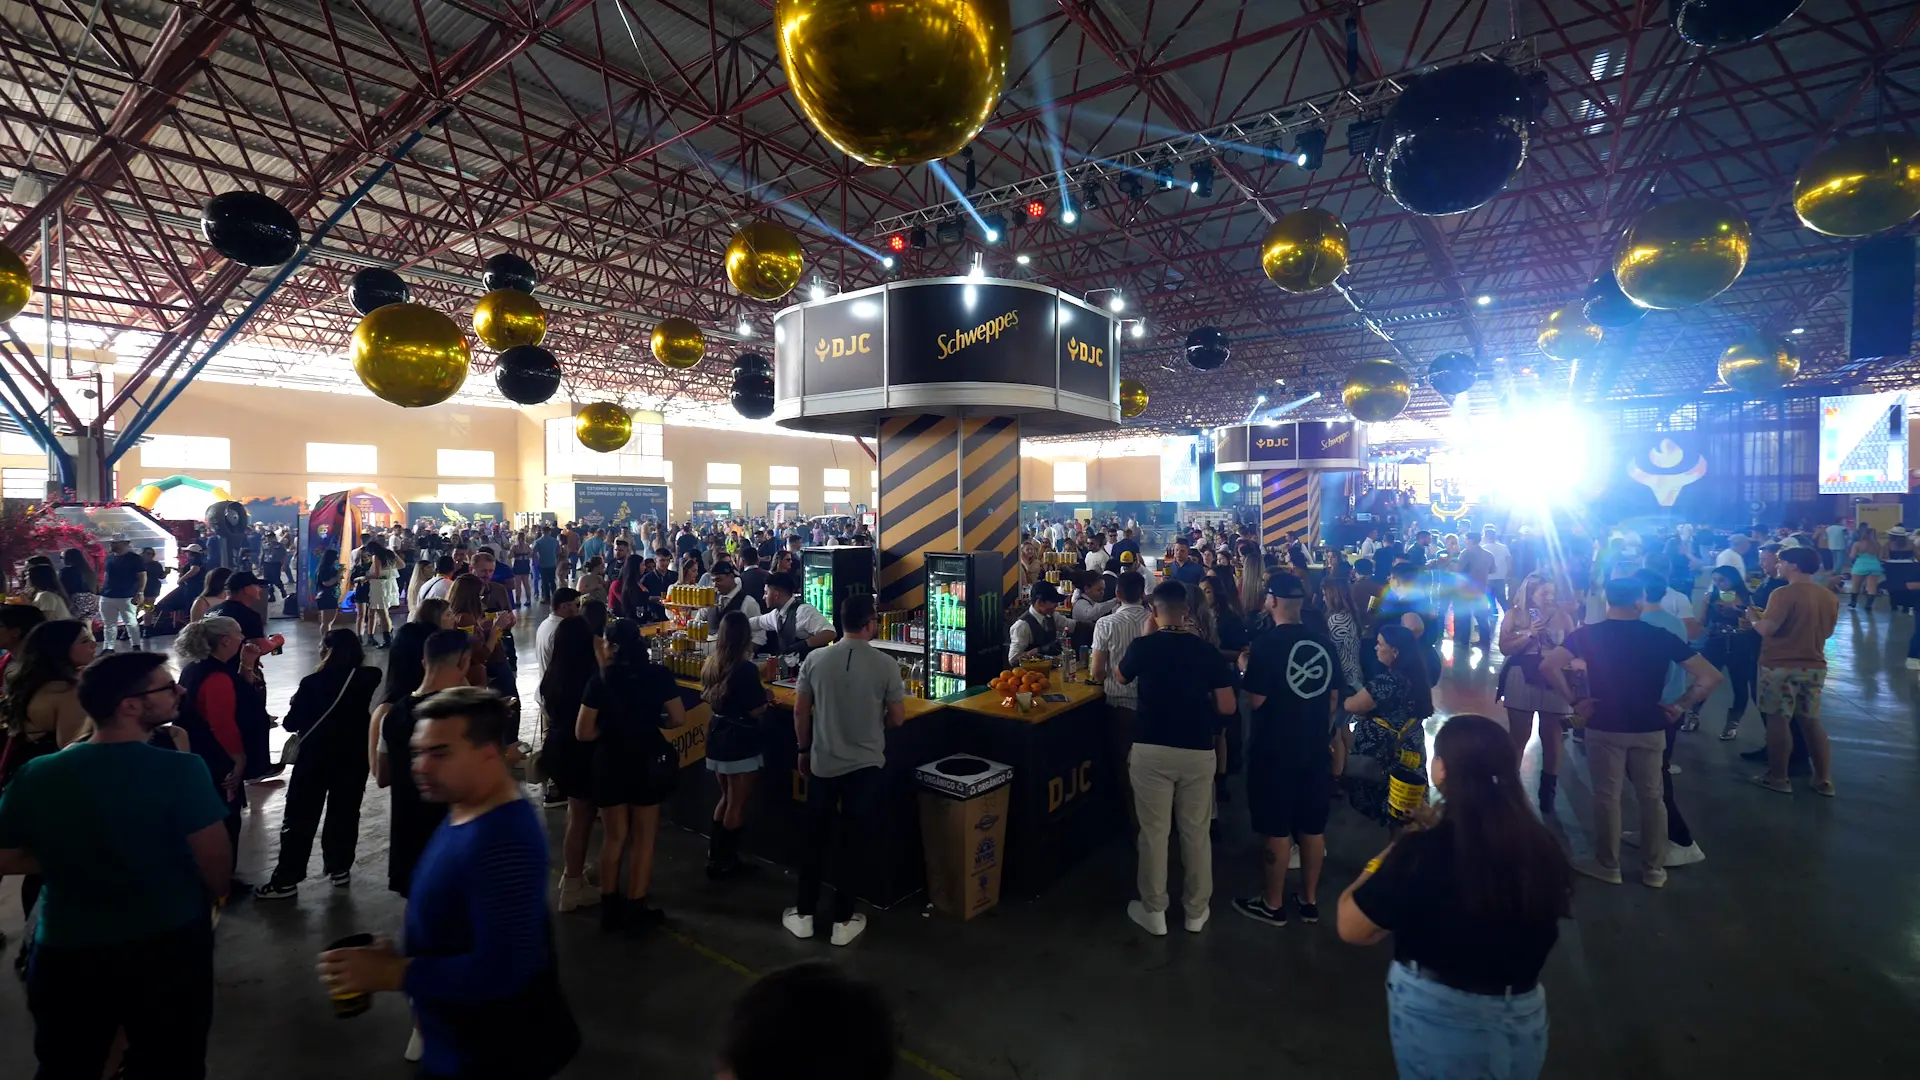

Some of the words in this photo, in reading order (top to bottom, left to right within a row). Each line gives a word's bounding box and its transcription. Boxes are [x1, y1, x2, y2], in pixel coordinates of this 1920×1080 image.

[831, 332, 871, 358] DJC
[937, 309, 1019, 360] Schweppes
[1079, 341, 1104, 367] DJC
[1266, 437, 1289, 448] DJC
[924, 775, 955, 790] ORGÂNICO
[977, 773, 1006, 792] ORGÂNICO
[1048, 760, 1092, 813] DJC
